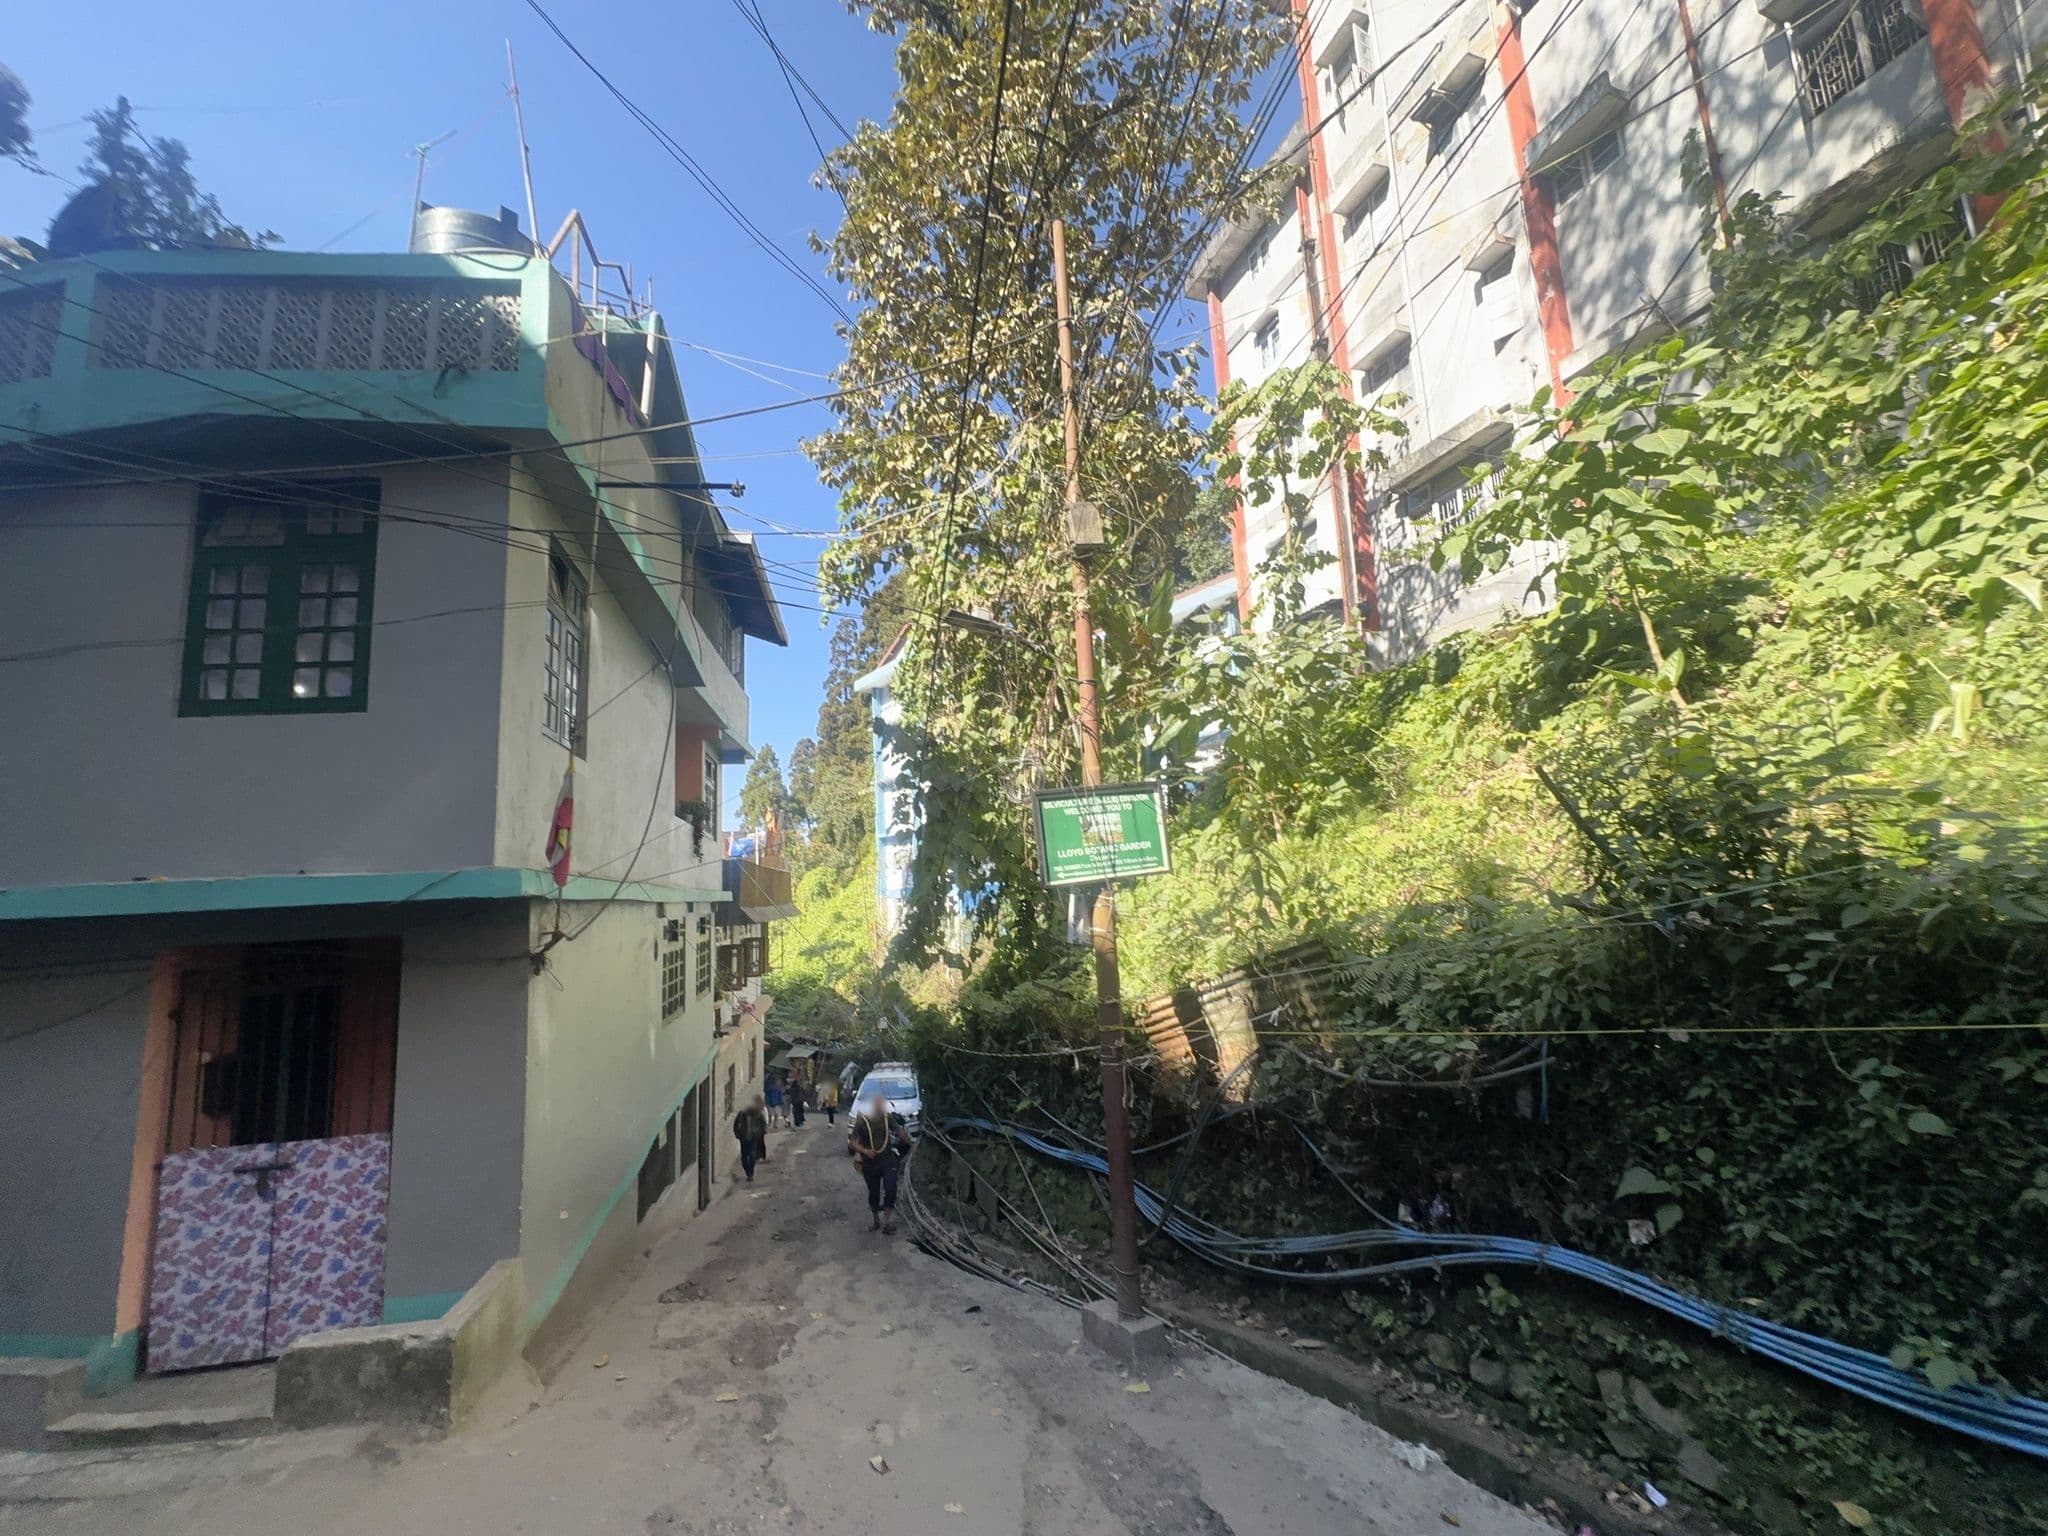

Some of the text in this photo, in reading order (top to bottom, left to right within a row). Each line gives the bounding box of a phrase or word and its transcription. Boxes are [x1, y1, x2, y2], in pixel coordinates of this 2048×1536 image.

[1106, 804, 1122, 812] YOU
[1122, 803, 1132, 811] TO
[1057, 848, 1084, 858] LLOYD
[1119, 841, 1152, 851] GARDEN
